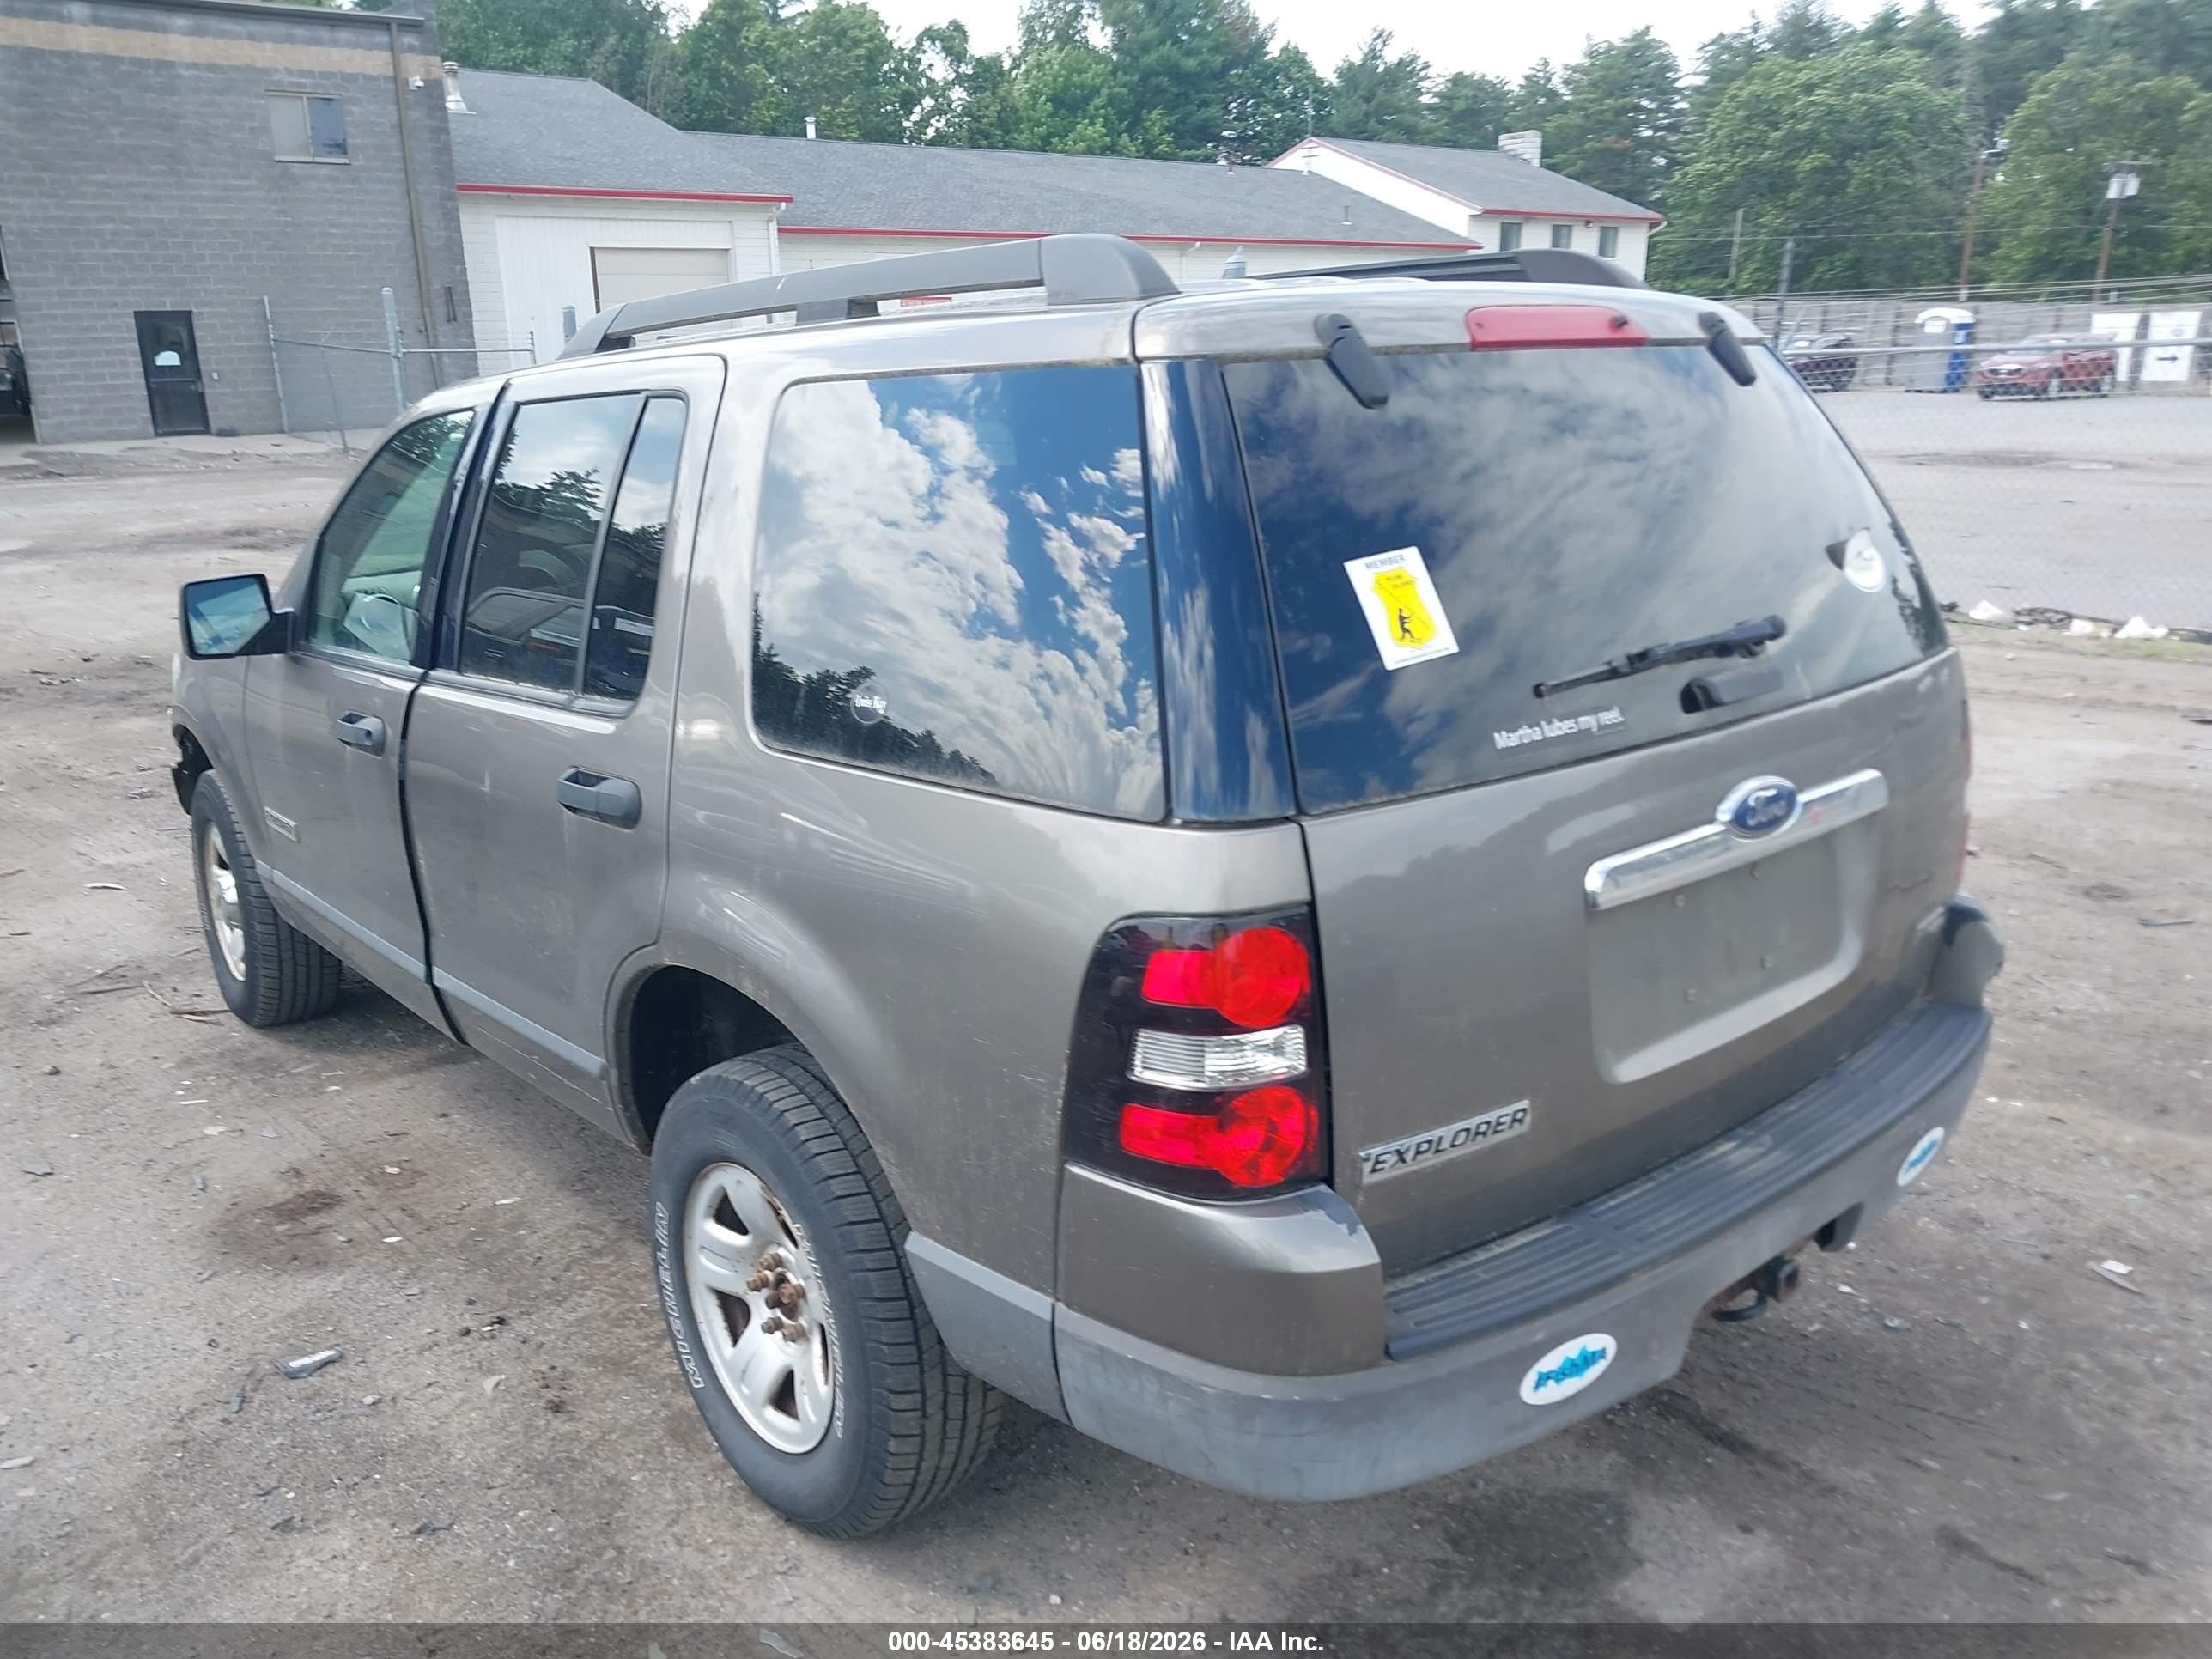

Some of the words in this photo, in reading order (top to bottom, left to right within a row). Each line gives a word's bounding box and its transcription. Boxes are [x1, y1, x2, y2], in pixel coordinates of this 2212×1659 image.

[1364, 554, 1406, 570] MEMBER
[1492, 725, 1544, 750] Martha
[1540, 718, 1578, 738] lubes
[1577, 714, 1598, 732] my
[1746, 787, 1788, 826] Ford
[1370, 1107, 1528, 1174] EXPLORER
[655, 1201, 705, 1389] MICHELIN
